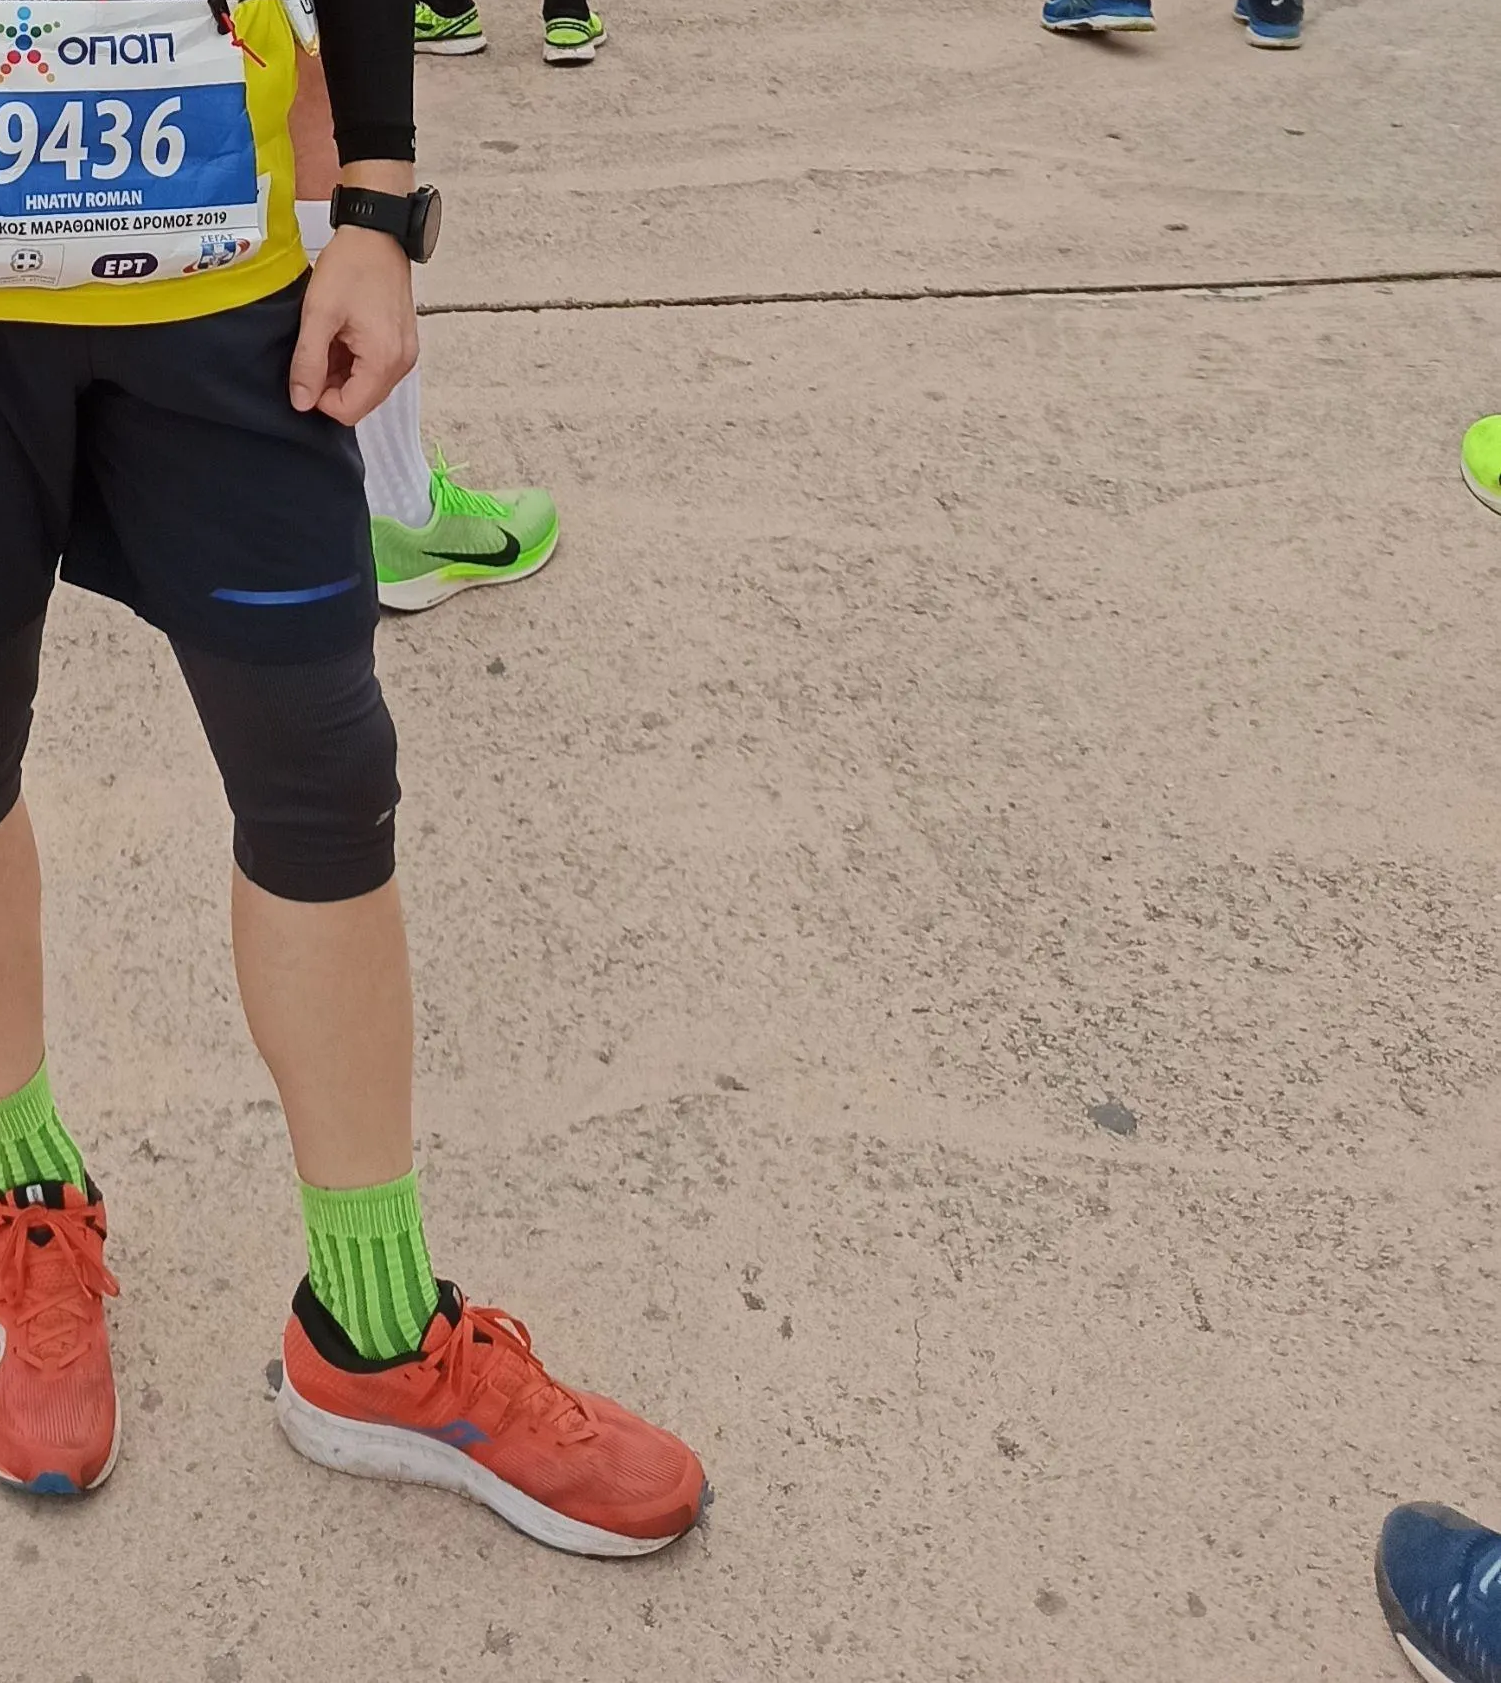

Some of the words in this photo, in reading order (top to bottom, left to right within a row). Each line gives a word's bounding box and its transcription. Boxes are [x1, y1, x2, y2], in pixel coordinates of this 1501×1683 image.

[26, 192, 84, 210] HNATIV
[86, 190, 143, 208] ROMAN
[30, 217, 130, 235] ΜΑΡΑΘΩΝΙΟΣ
[132, 214, 194, 230] ΔΡΟΜΟΣ
[196, 212, 227, 227] 2019
